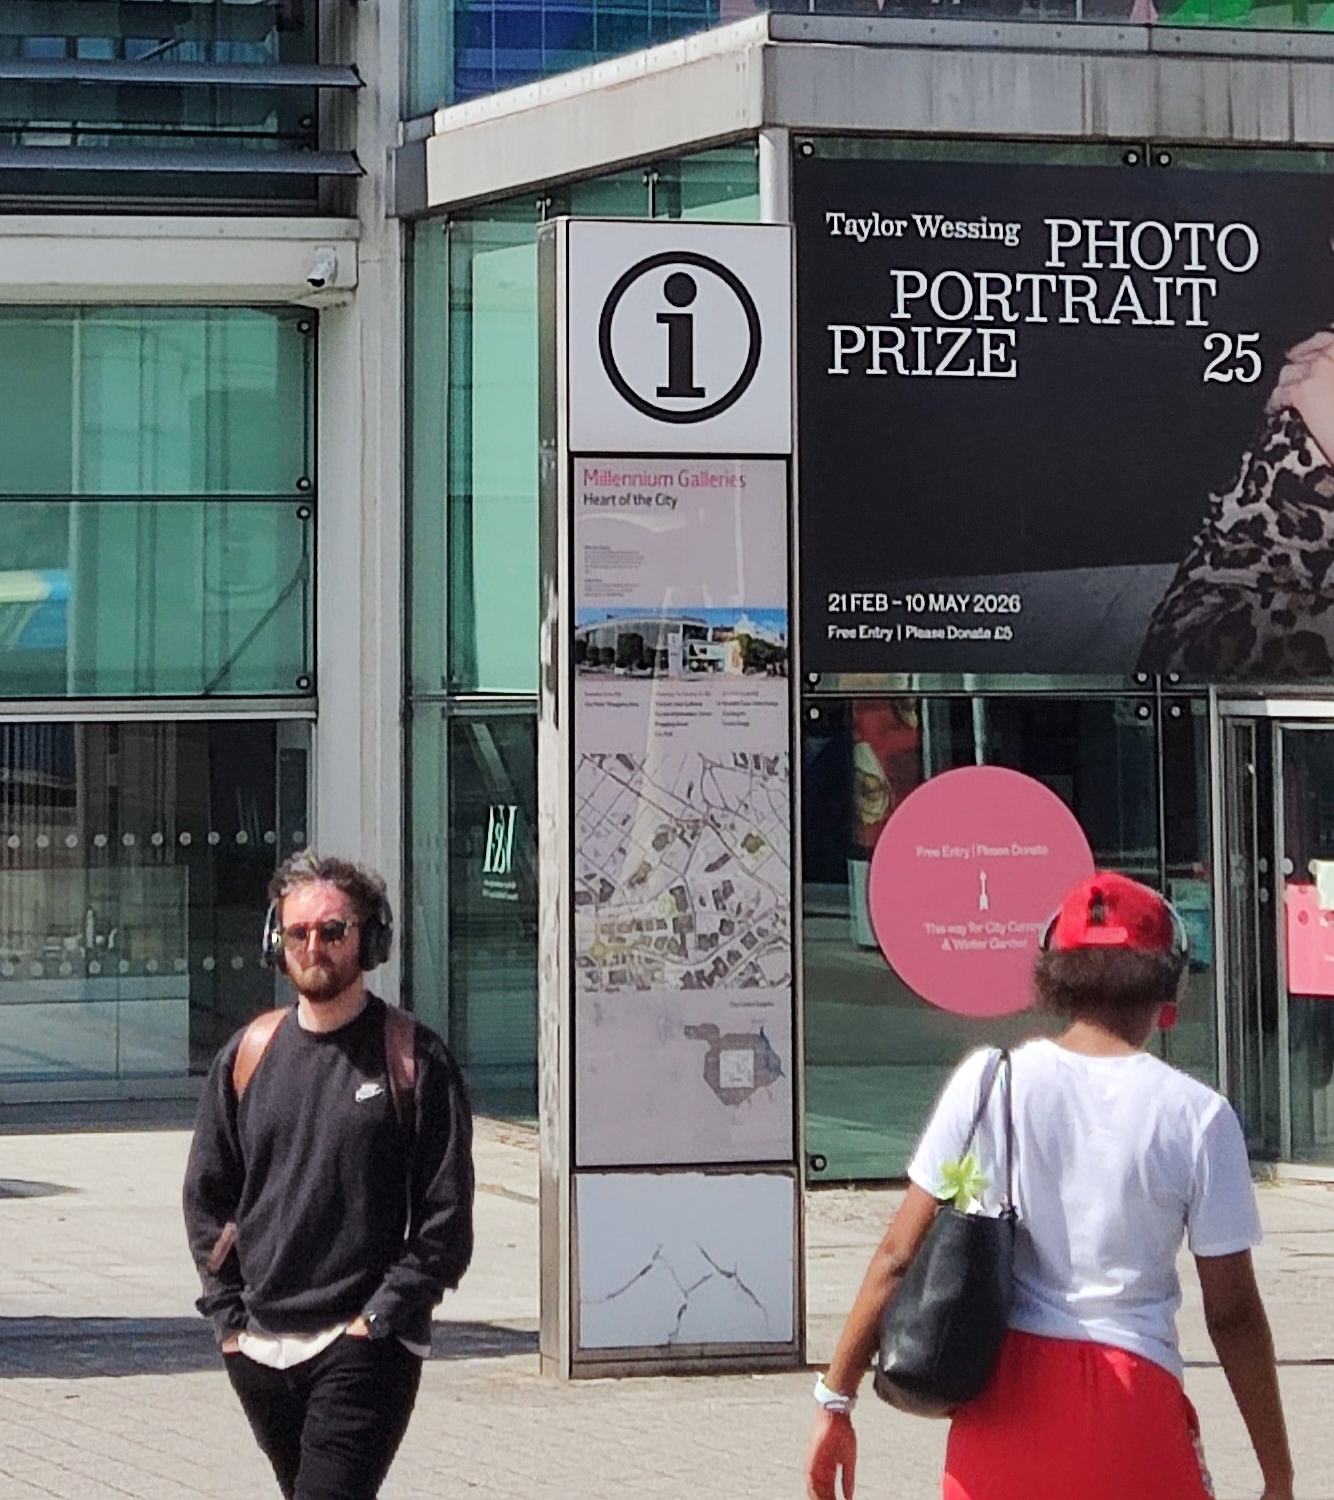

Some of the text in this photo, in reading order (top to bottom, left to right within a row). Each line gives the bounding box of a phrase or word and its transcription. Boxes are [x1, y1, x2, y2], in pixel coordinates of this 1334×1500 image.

[826, 212, 1260, 273] Taylor Wessing PHOTO
[889, 269, 1217, 327] PORTRAIT
[827, 325, 1263, 383] PRIZE 25
[583, 468, 747, 489] Millennium Galleries
[583, 493, 677, 510] Heart of the City
[828, 593, 847, 612] 21
[850, 593, 888, 612] FEB
[905, 594, 925, 612] 10
[928, 594, 970, 612] MAY
[973, 594, 1021, 613] 2026
[828, 625, 857, 639] Free
[858, 625, 893, 642] Entry
[905, 625, 946, 639] Please
[947, 625, 991, 639] Donate
